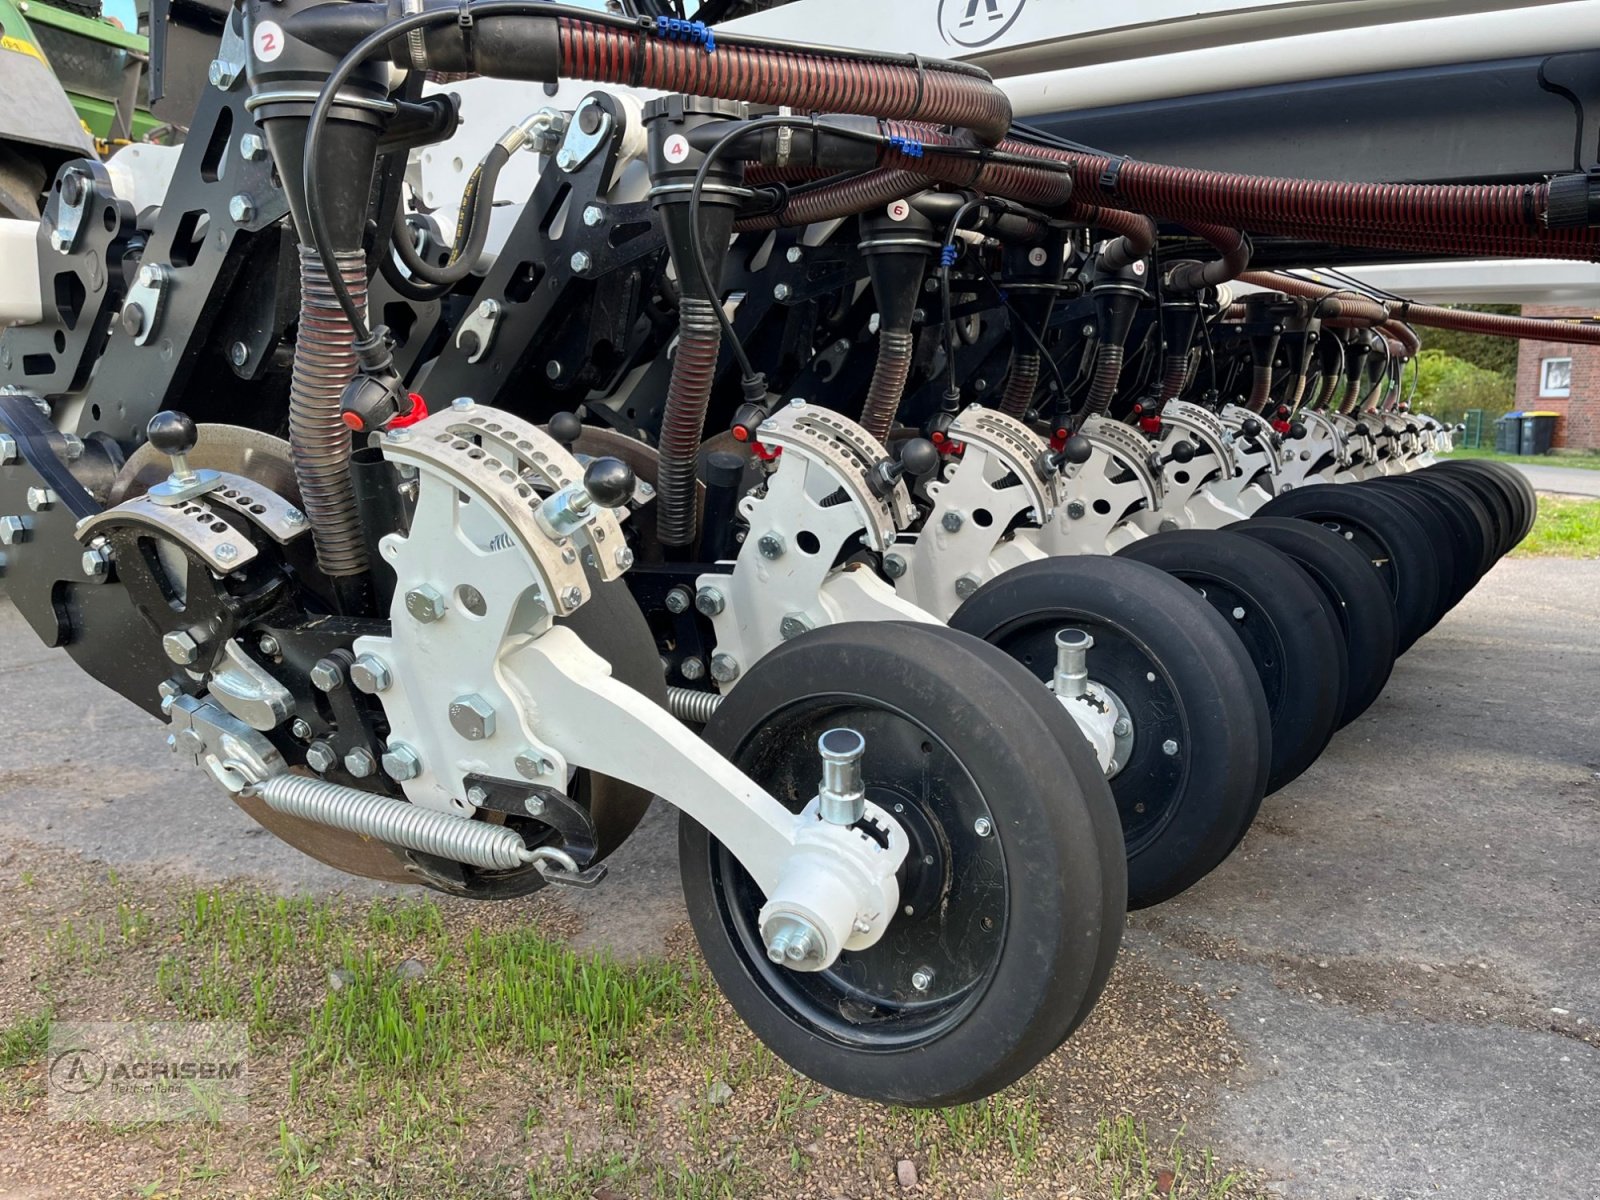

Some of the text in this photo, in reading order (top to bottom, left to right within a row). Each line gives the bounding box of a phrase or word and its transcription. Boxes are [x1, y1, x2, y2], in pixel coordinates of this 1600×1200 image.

[261, 33, 276, 53] 2
[671, 143, 683, 155] 4
[894, 205, 904, 216] 6
